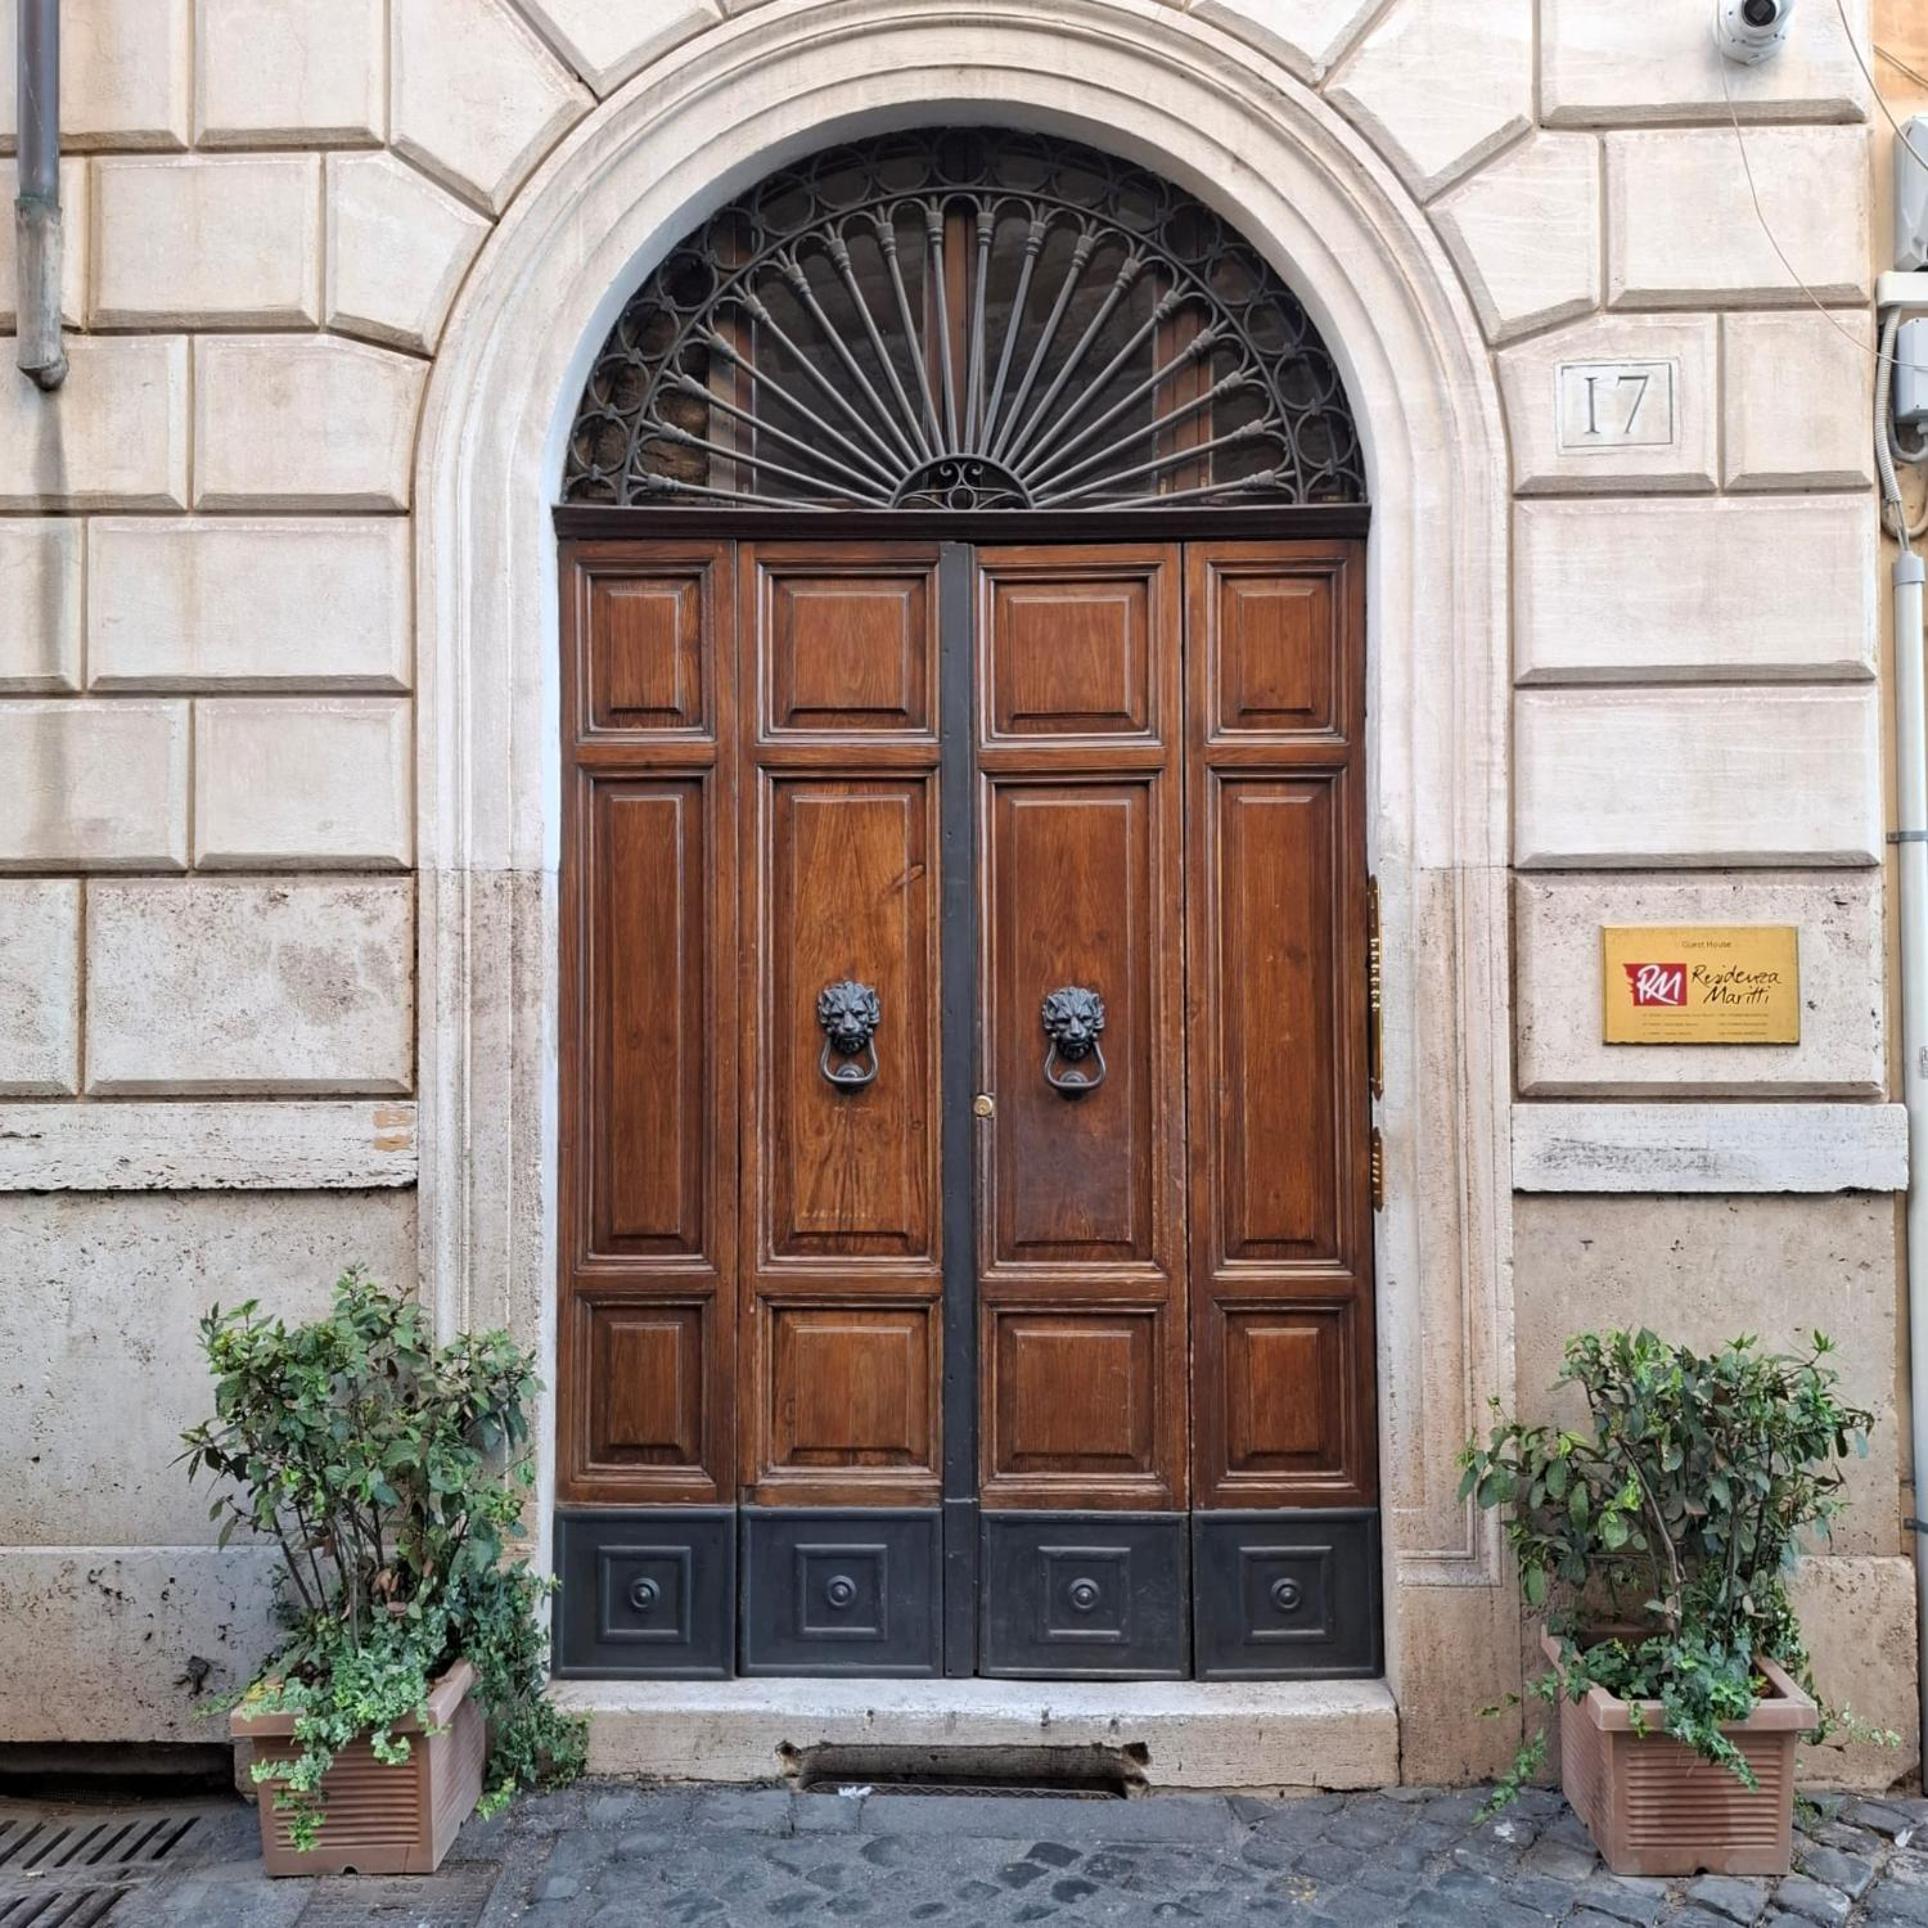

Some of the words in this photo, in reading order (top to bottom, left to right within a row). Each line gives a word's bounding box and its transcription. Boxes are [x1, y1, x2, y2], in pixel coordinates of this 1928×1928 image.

[1584, 375, 1650, 434] 17
[1681, 940, 1704, 949] Guest
[1706, 940, 1732, 949] House
[1637, 964, 1682, 1005] RM
[1691, 964, 1782, 985] Residenza
[1703, 985, 1771, 1005] Maritti
